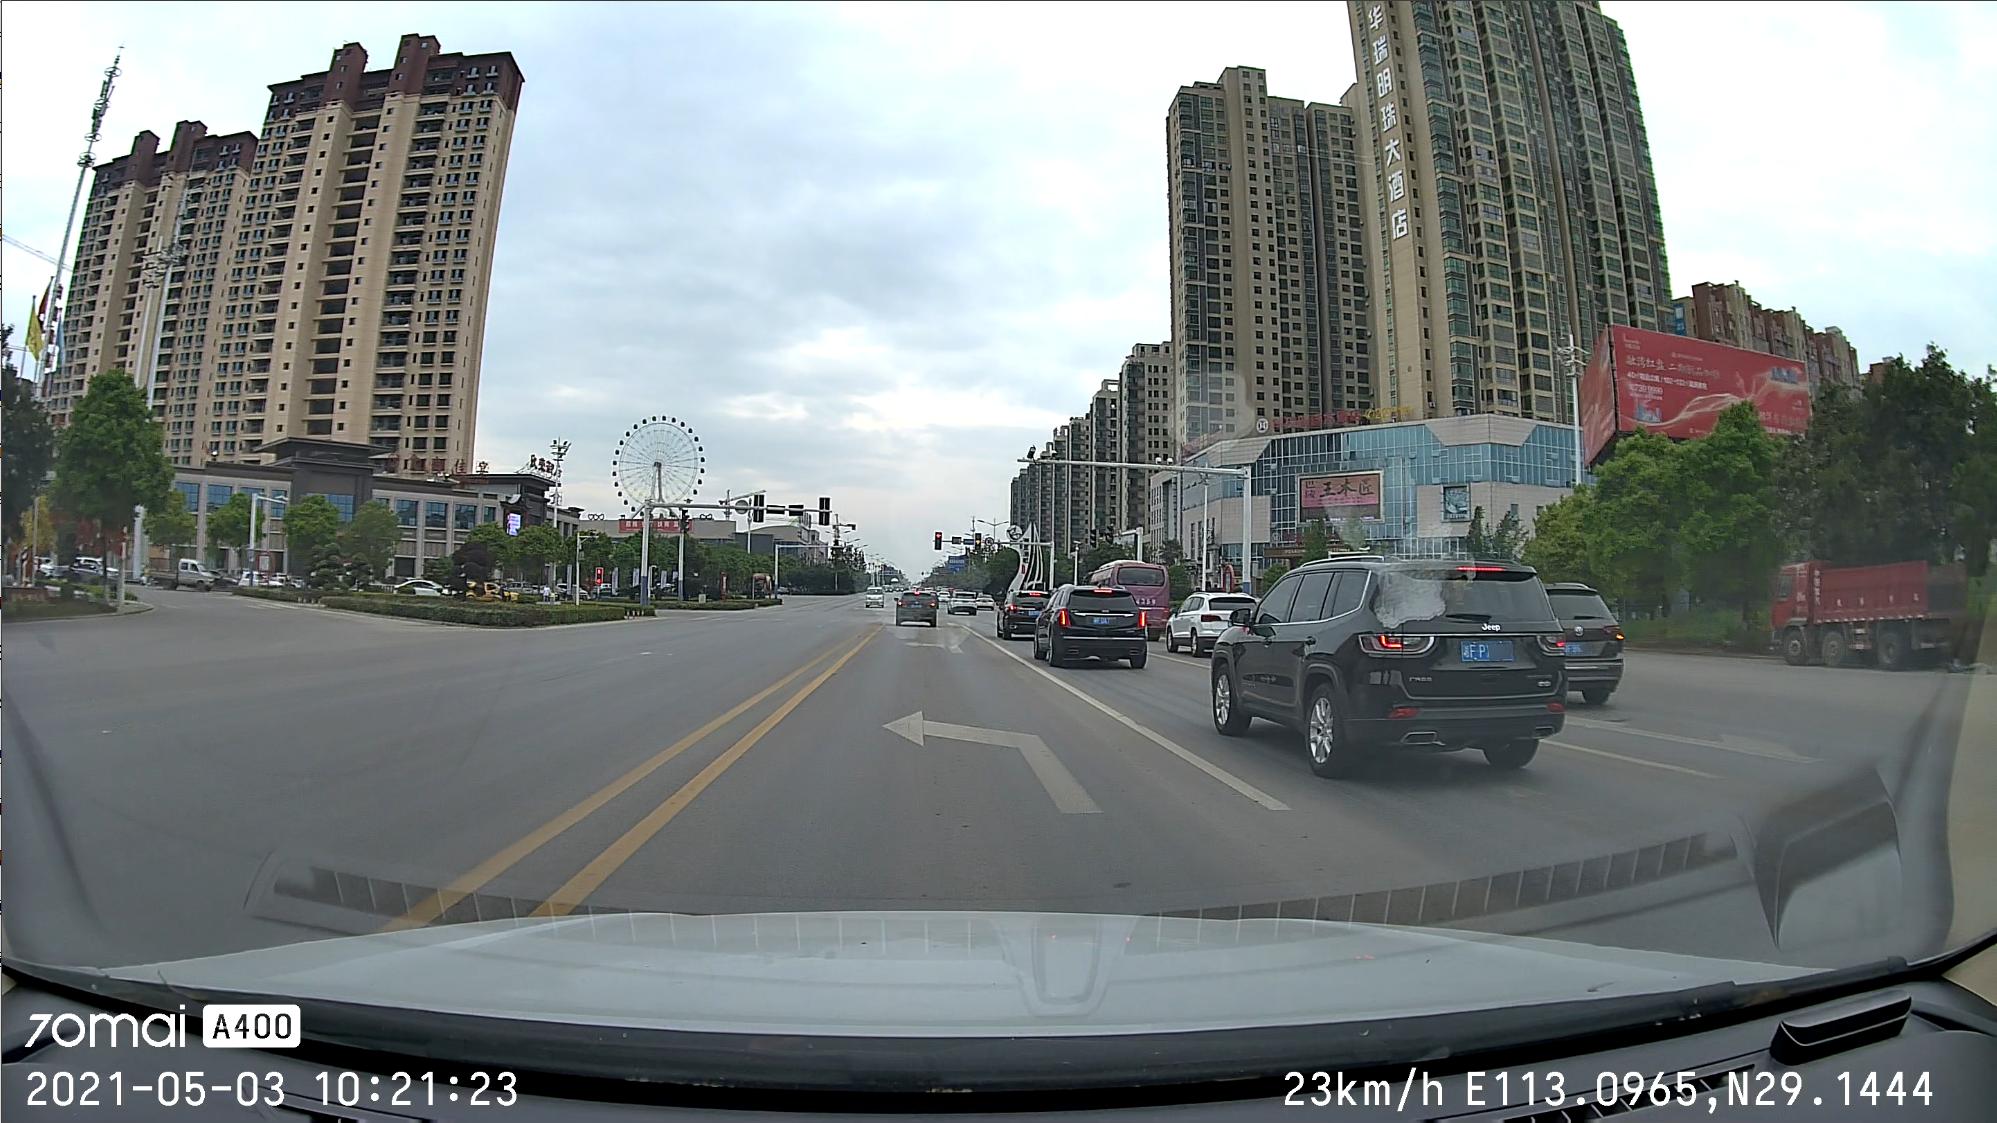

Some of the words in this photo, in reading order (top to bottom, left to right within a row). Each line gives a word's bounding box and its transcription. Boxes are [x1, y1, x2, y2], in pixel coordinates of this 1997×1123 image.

[1367, 3, 1409, 240] 华瑞明珠大酒店
[1481, 623, 1501, 632] Jeep
